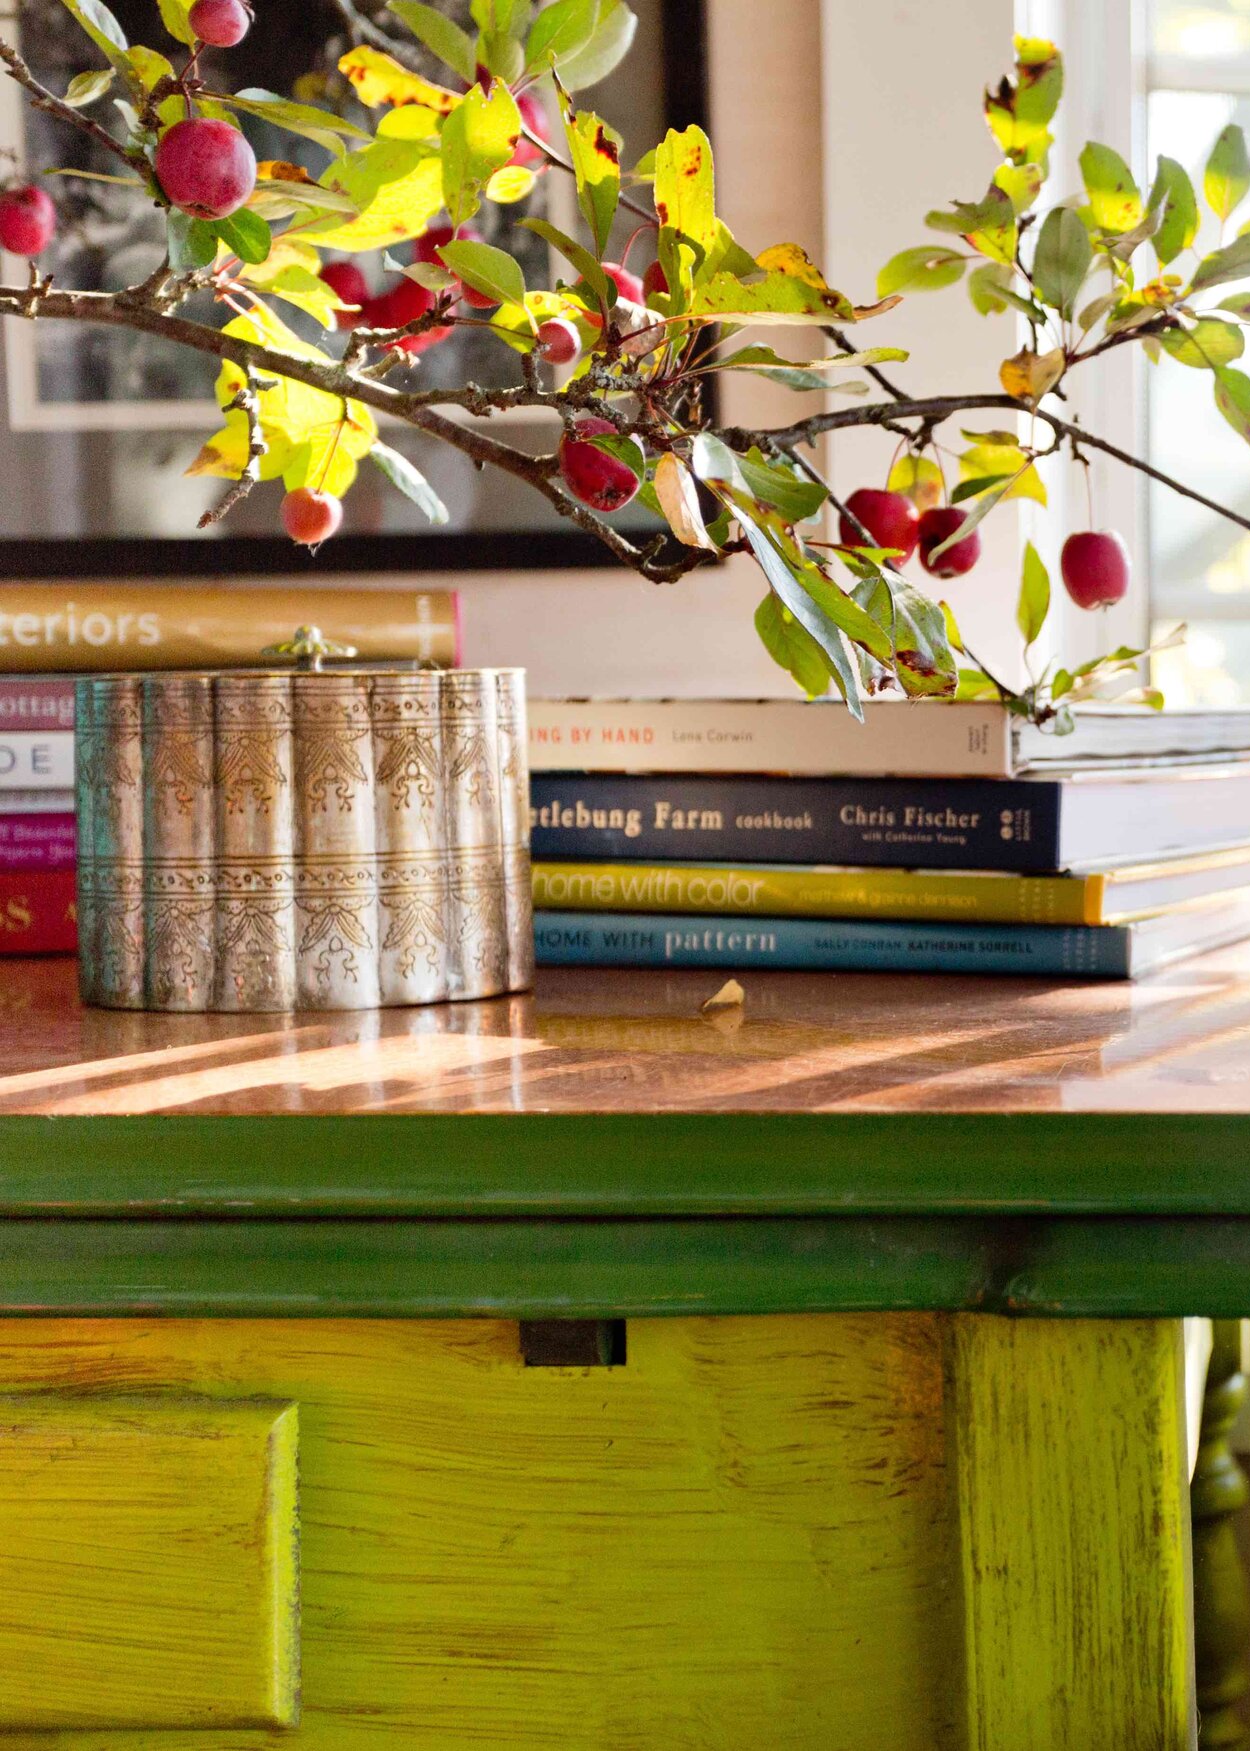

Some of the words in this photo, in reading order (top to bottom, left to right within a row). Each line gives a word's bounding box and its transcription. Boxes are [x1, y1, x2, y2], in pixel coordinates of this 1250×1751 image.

[529, 727, 561, 744] ING
[571, 727, 592, 744] BY
[601, 727, 655, 744] HAND
[672, 729, 701, 743] Lena
[706, 729, 753, 743] Corwin
[655, 801, 723, 830] Farm
[736, 810, 813, 830] cookbook
[840, 804, 896, 827] Chris
[904, 806, 981, 829] Fischer
[862, 831, 882, 842] with
[531, 866, 615, 901] home
[620, 868, 683, 904] with
[687, 871, 766, 907] color
[603, 931, 654, 948] WITH
[664, 928, 777, 960] pattern
[814, 938, 849, 951] SALLY
[908, 940, 975, 953] KATHERINE
[979, 941, 1033, 954] SORRELL
